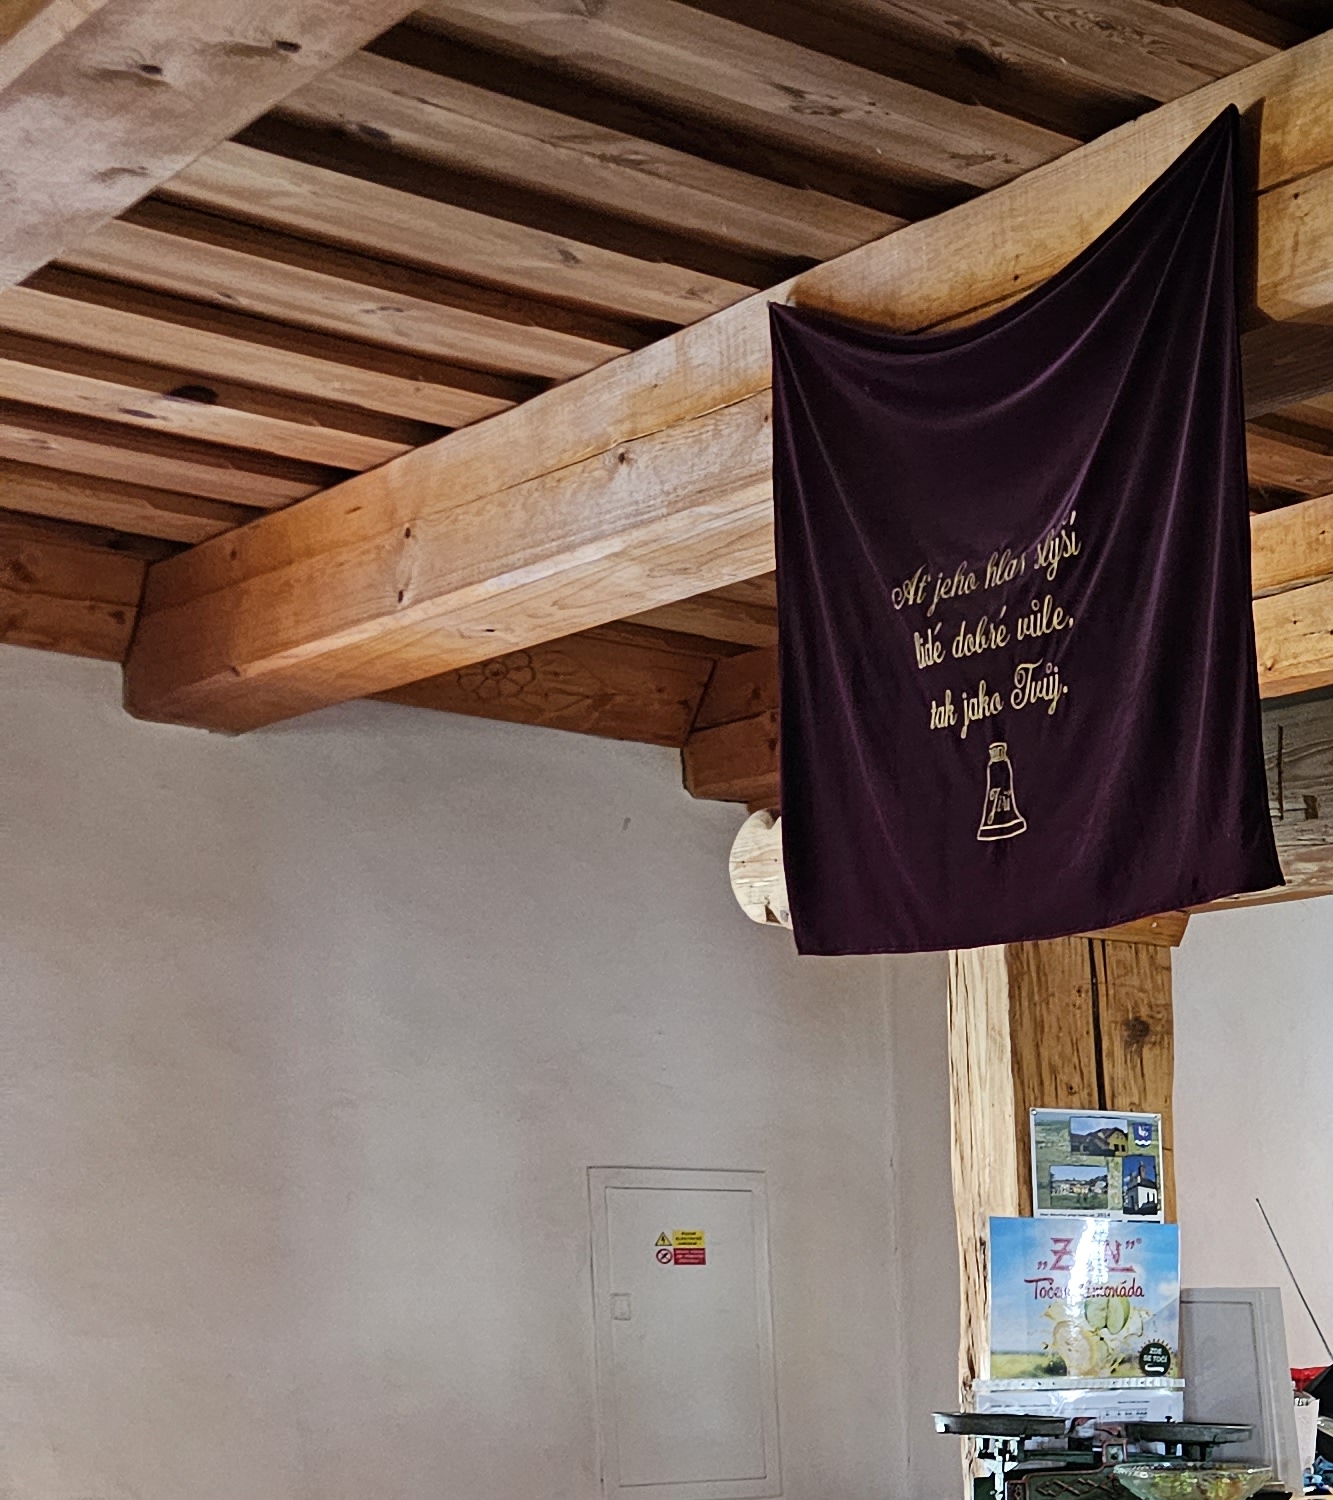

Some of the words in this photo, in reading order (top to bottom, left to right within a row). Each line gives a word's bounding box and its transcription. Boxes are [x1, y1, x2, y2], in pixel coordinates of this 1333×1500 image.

[927, 560, 980, 617] jeho
[914, 621, 946, 669] lidé
[952, 605, 1011, 658] dobré
[1017, 595, 1074, 640] vůle,
[930, 689, 957, 729] tak
[960, 680, 1004, 739] jako
[1011, 657, 1068, 715] Tvůj.
